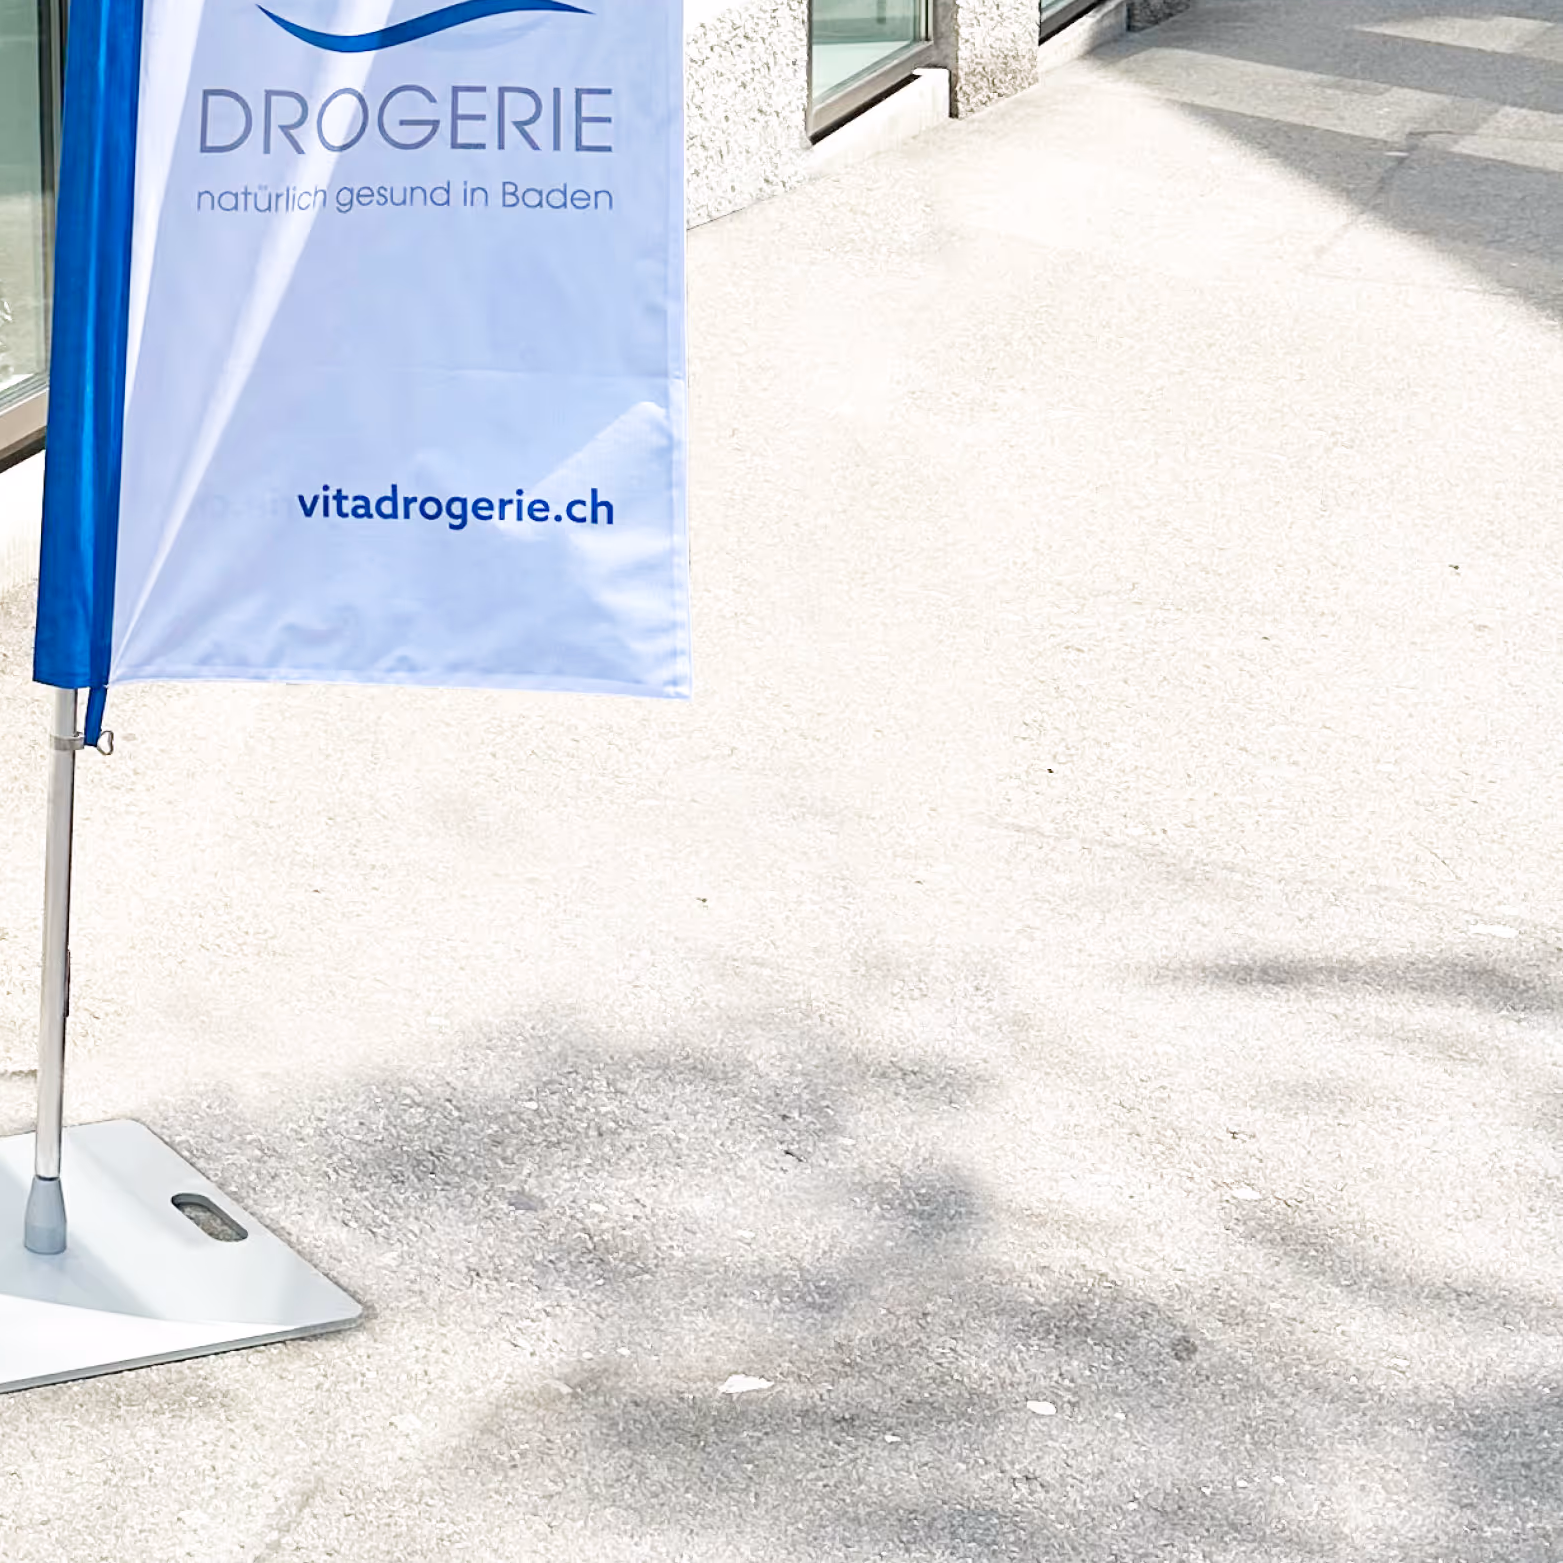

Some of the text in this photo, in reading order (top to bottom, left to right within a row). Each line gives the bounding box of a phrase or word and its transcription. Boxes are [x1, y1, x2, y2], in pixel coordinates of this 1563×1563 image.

[198, 83, 614, 155] DROGERIE
[196, 180, 614, 214] natürlich gesund in Baden
[297, 483, 615, 531] vitadrogerie.ch
